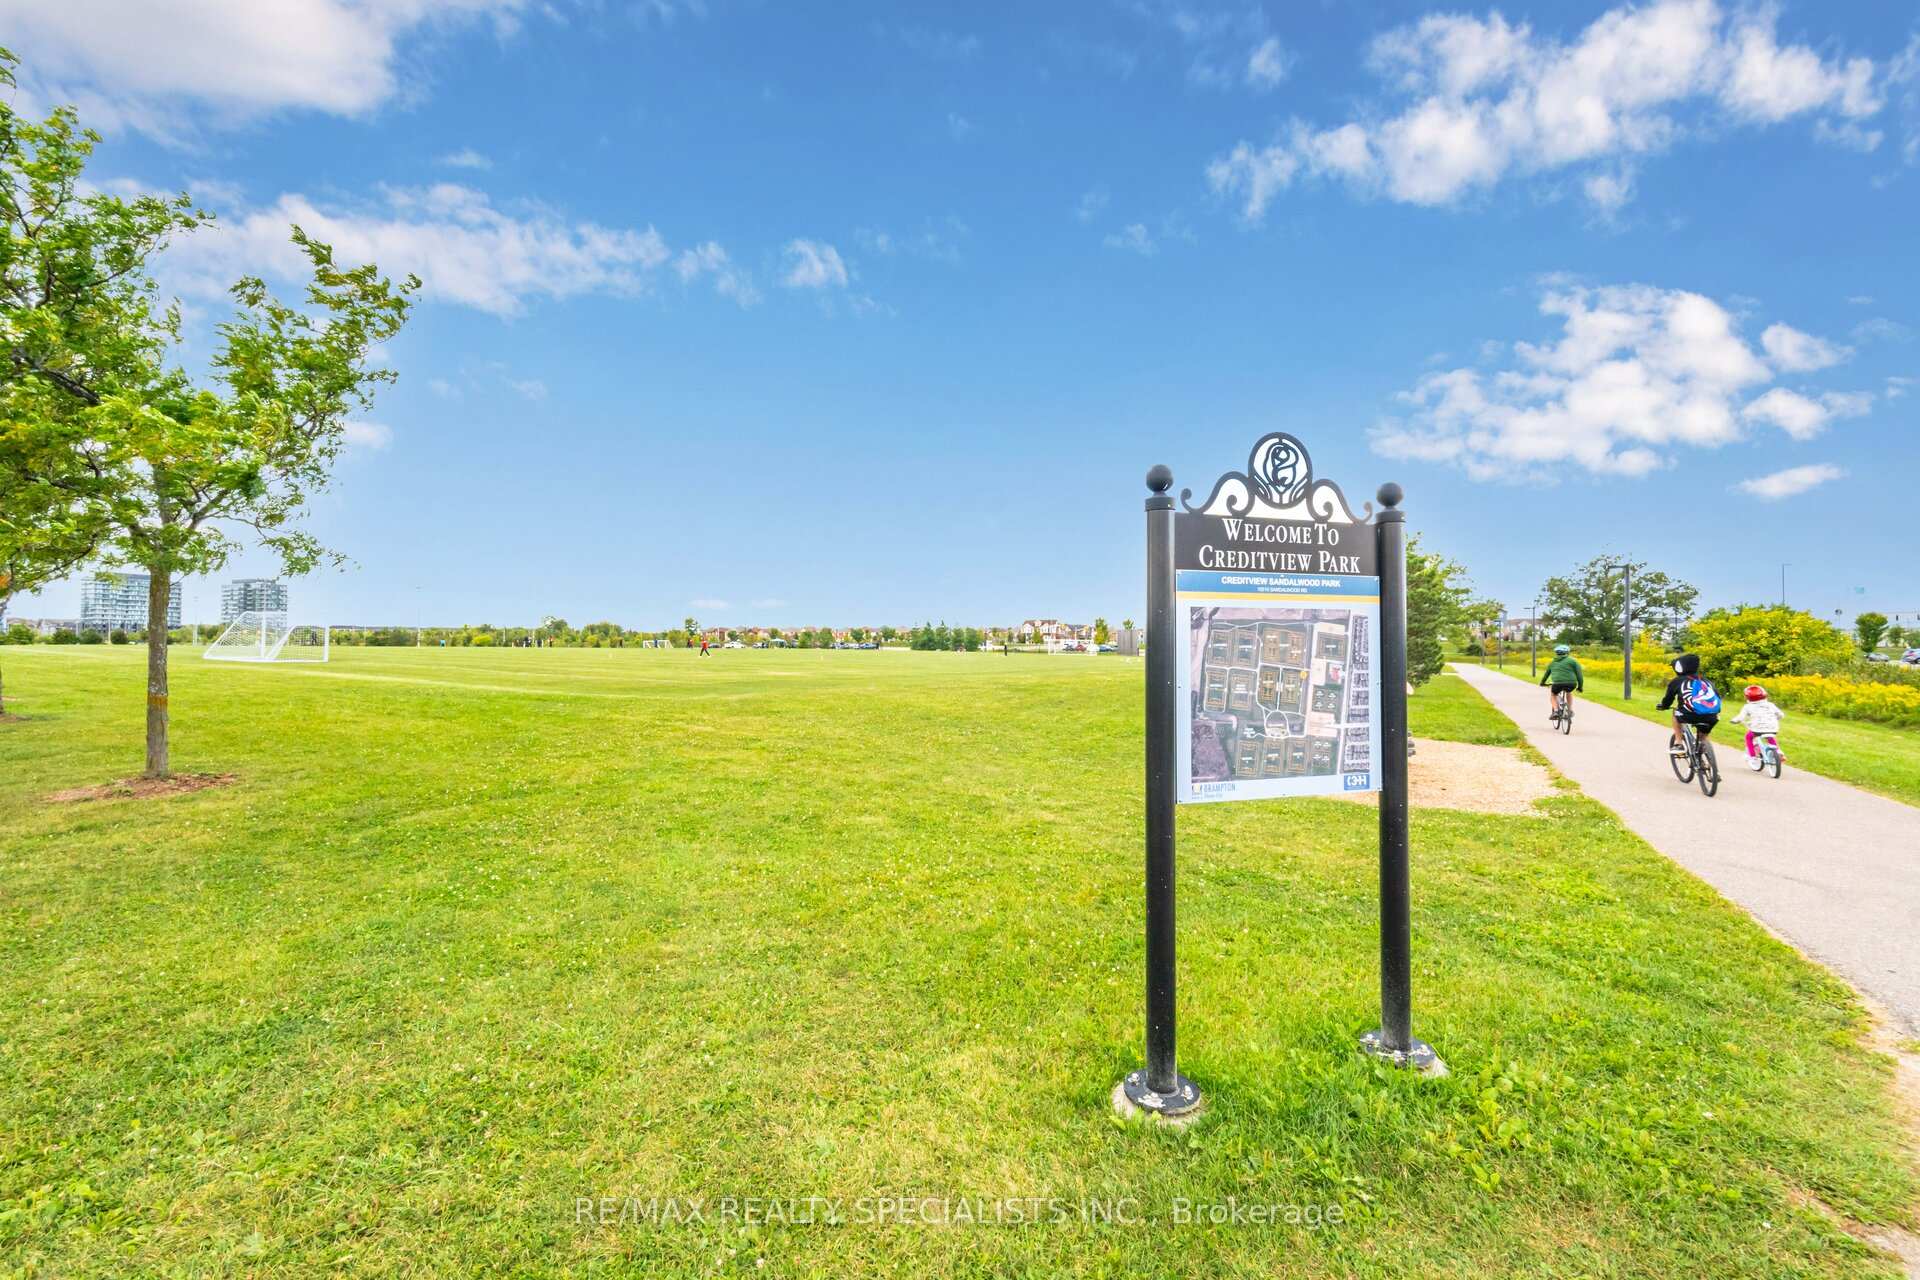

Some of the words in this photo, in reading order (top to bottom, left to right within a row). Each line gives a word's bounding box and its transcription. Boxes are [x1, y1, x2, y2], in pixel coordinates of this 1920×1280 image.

[1222, 518, 1312, 545] WELCOME
[1314, 523, 1339, 546] TO
[1199, 545, 1312, 571] CREDITVIEW
[1318, 550, 1360, 573] PARK
[1221, 576, 1268, 585] CREDITVIEW
[1269, 578, 1320, 587] SANDALWOOD
[1321, 579, 1341, 588] PARK
